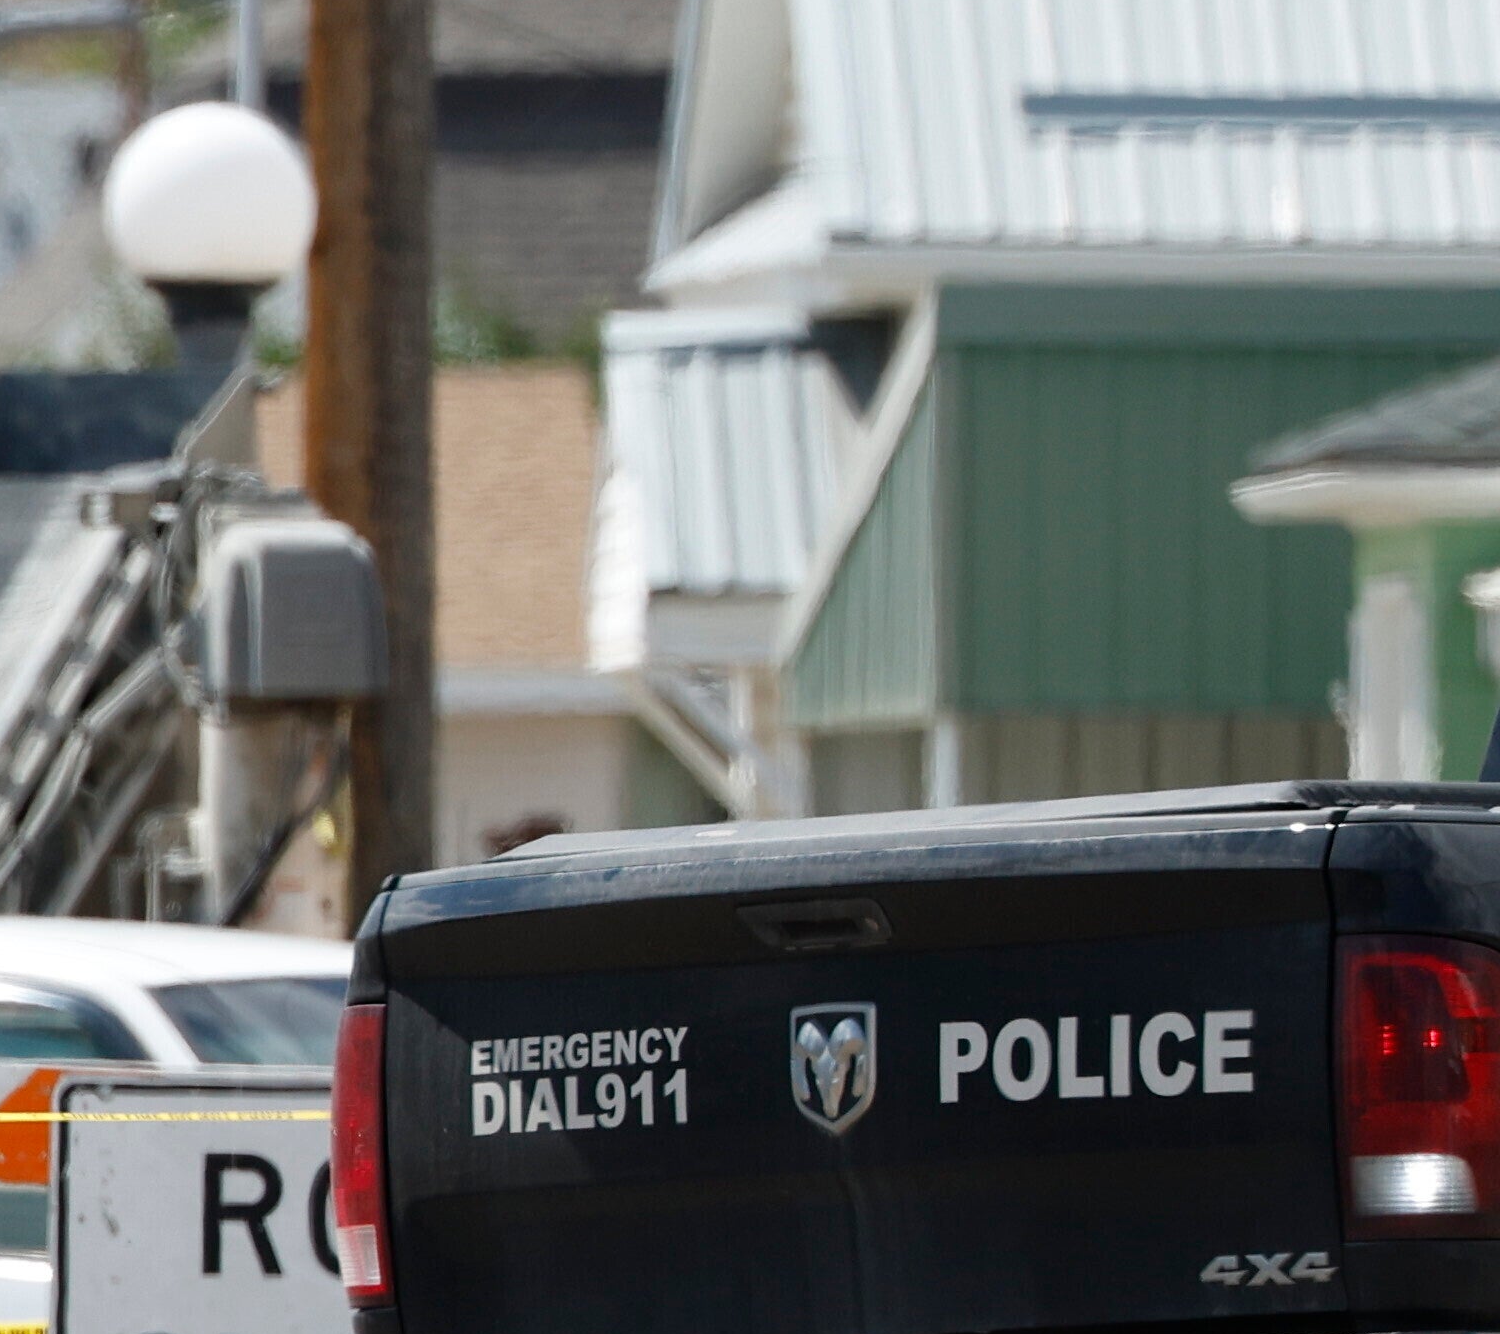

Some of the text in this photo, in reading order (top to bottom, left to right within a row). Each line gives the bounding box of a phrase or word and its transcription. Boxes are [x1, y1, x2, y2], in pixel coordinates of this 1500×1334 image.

[471, 1026, 689, 1076] EMERGENCY
[939, 1008, 1255, 1104] POLICE
[1200, 1251, 1340, 1288] 4X4
